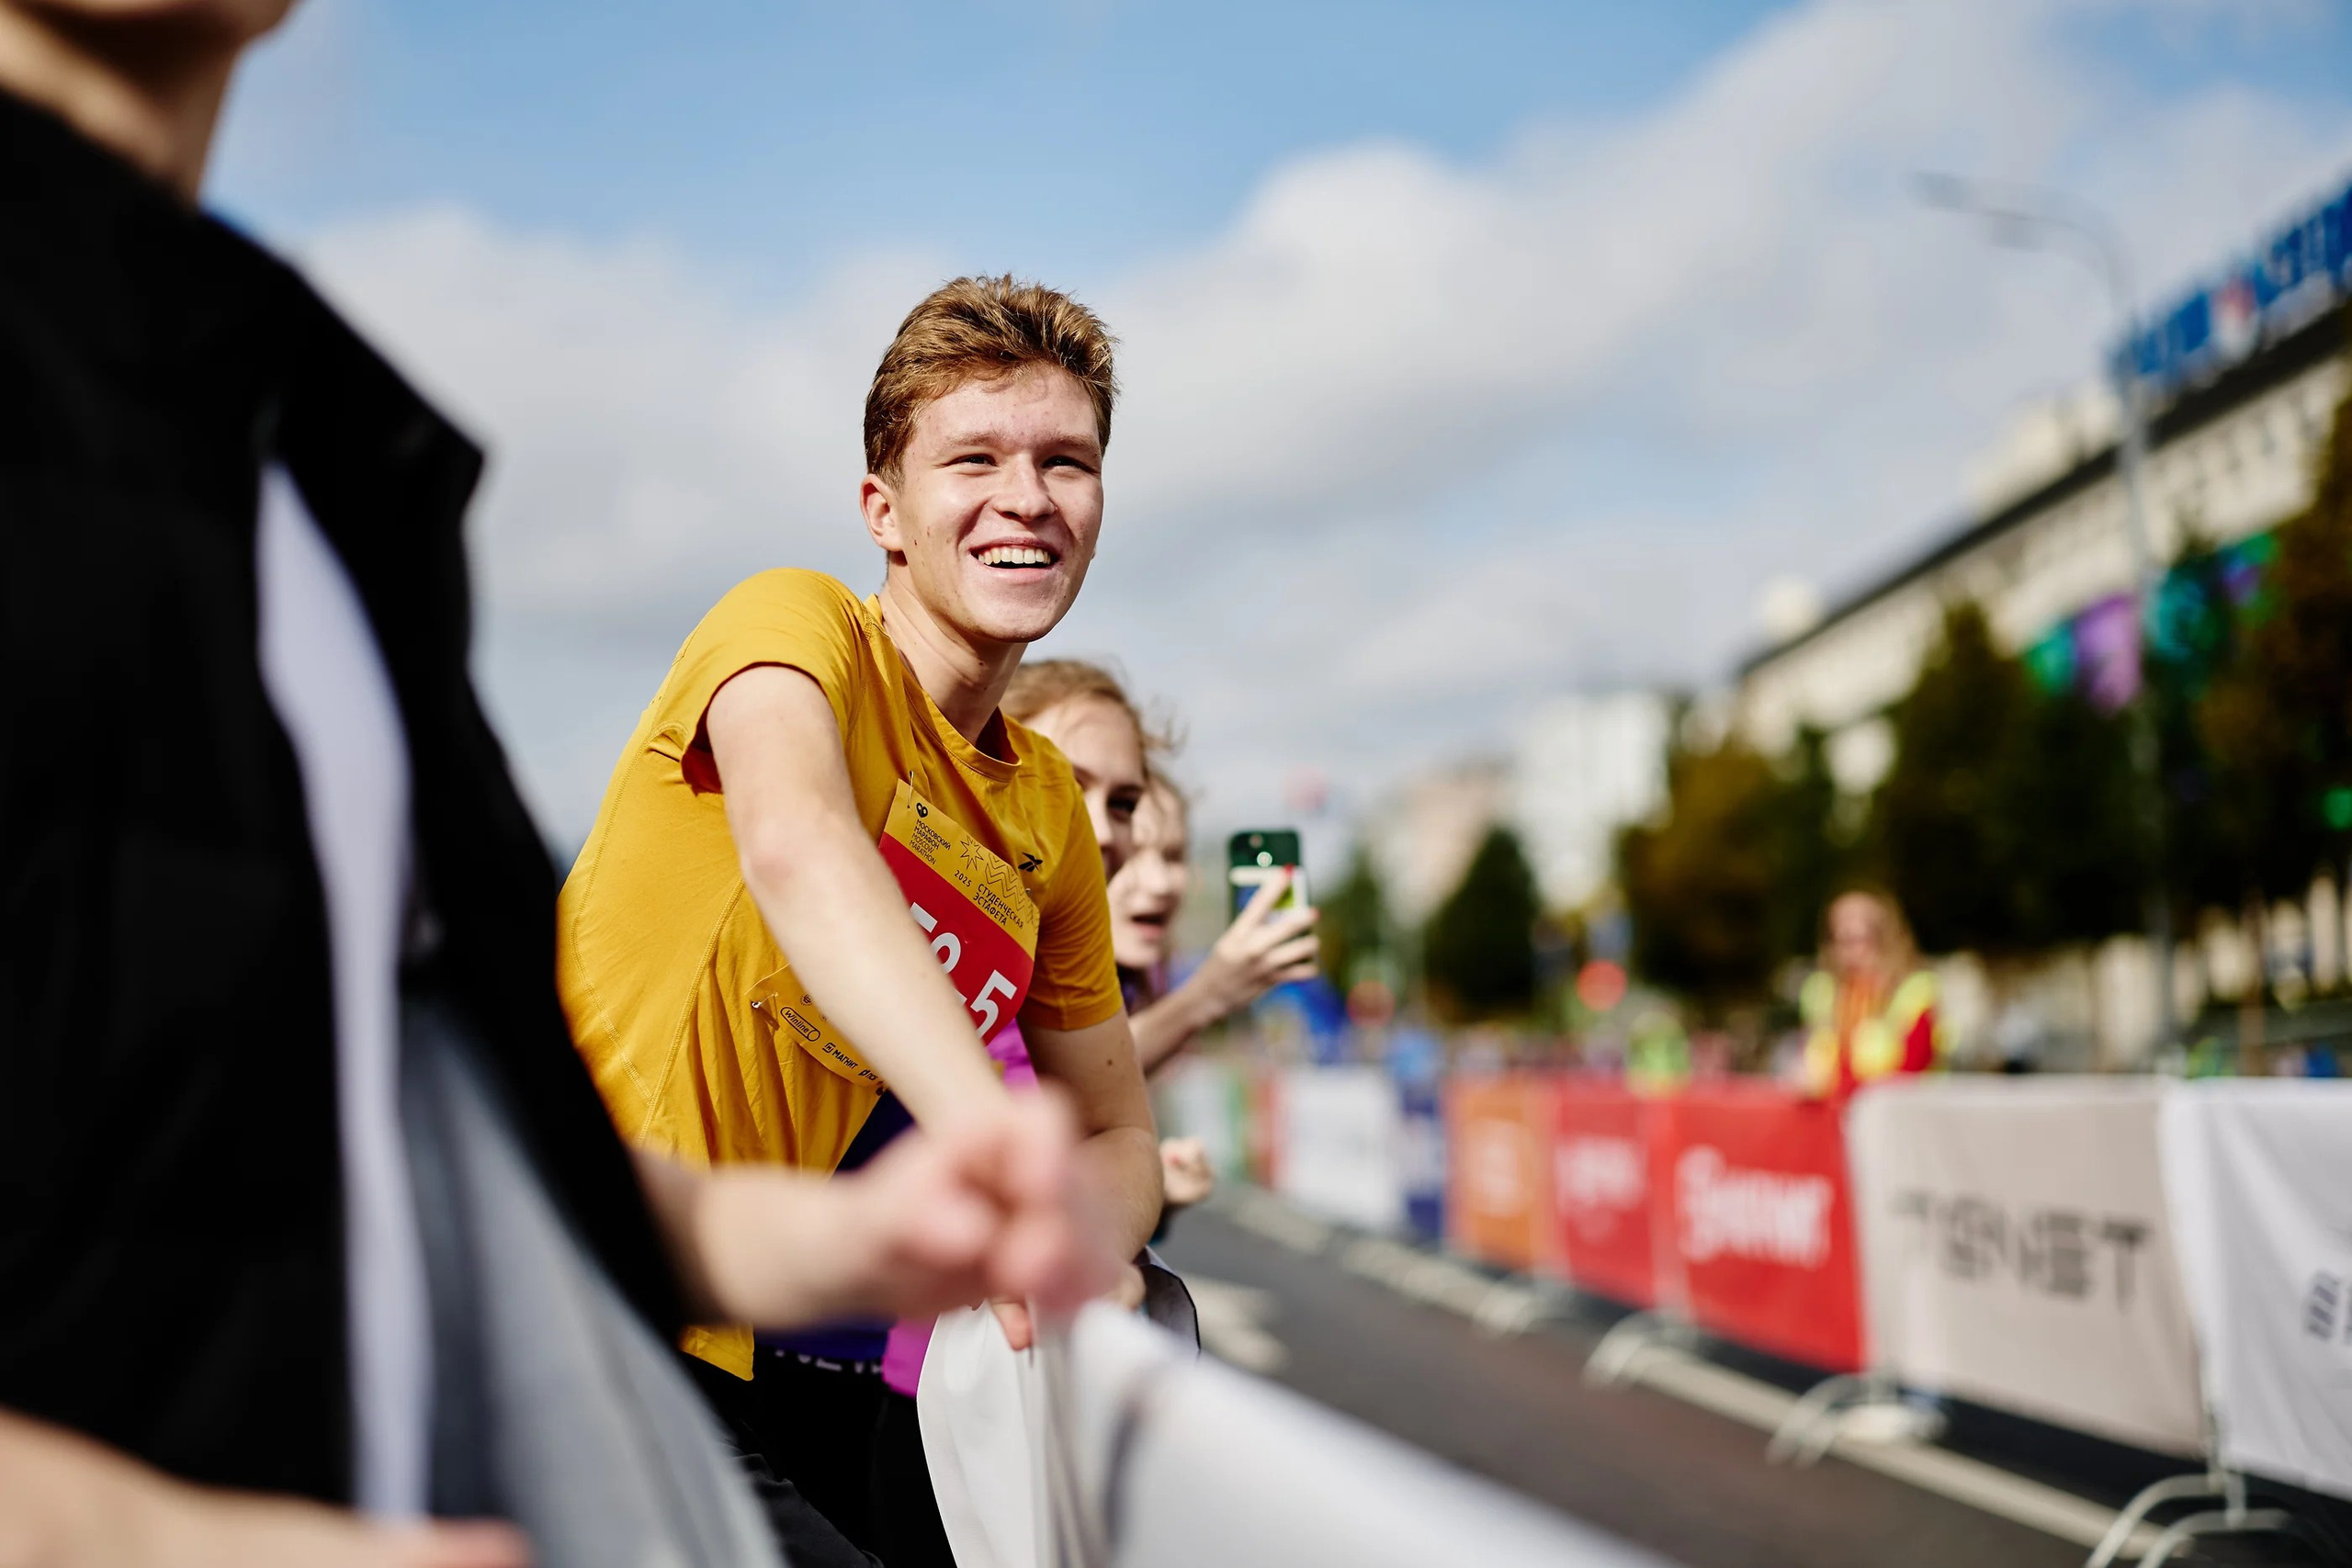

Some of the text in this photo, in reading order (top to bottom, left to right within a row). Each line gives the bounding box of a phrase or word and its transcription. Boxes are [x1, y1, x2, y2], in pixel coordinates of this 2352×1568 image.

[912, 832, 934, 853] MOSCOW
[914, 826, 939, 850] МАРАФОН
[910, 840, 936, 864] MARATHON
[954, 869, 972, 887] 2025
[973, 892, 1007, 926] ЭСТАФЕТА
[978, 884, 1023, 930] СТУДЕНЧЕСКАЯ
[785, 1010, 809, 1033] Winline
[832, 1049, 858, 1069] МАГНИТ
